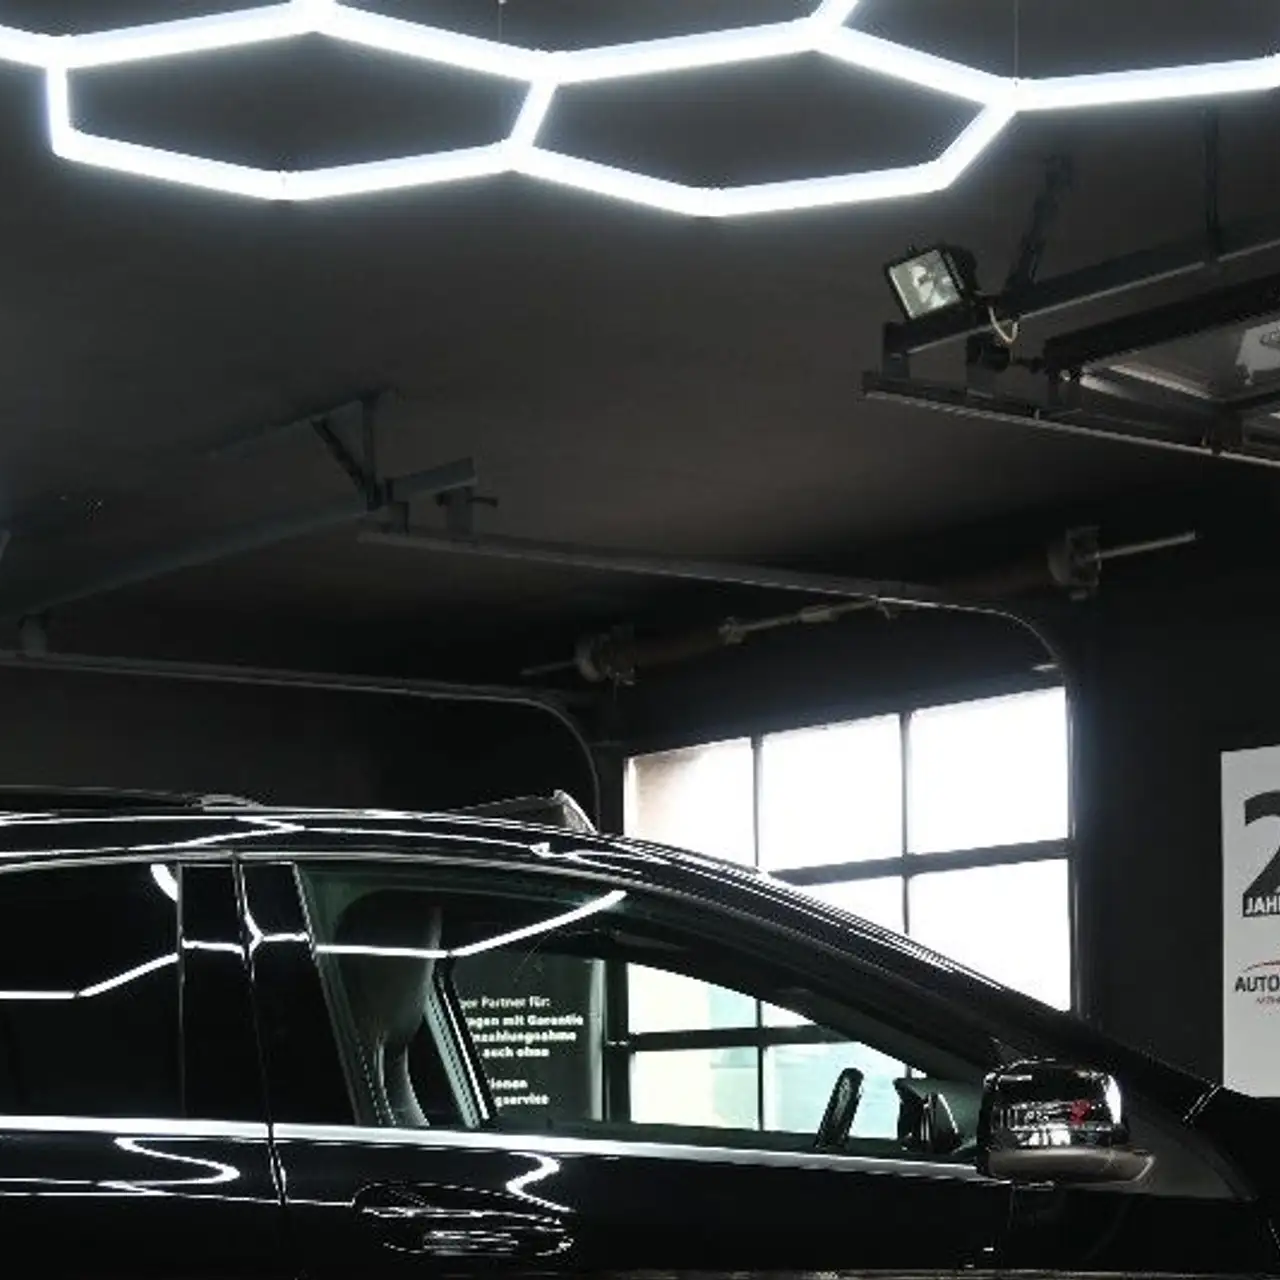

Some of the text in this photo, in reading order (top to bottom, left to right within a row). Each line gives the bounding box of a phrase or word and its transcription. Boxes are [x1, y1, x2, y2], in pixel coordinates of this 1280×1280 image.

[481, 996, 526, 1008] Partner
[529, 995, 551, 1008] für:
[503, 1015, 524, 1026] mit
[527, 1014, 583, 1026] Garantie
[516, 1047, 550, 1057] ohne
